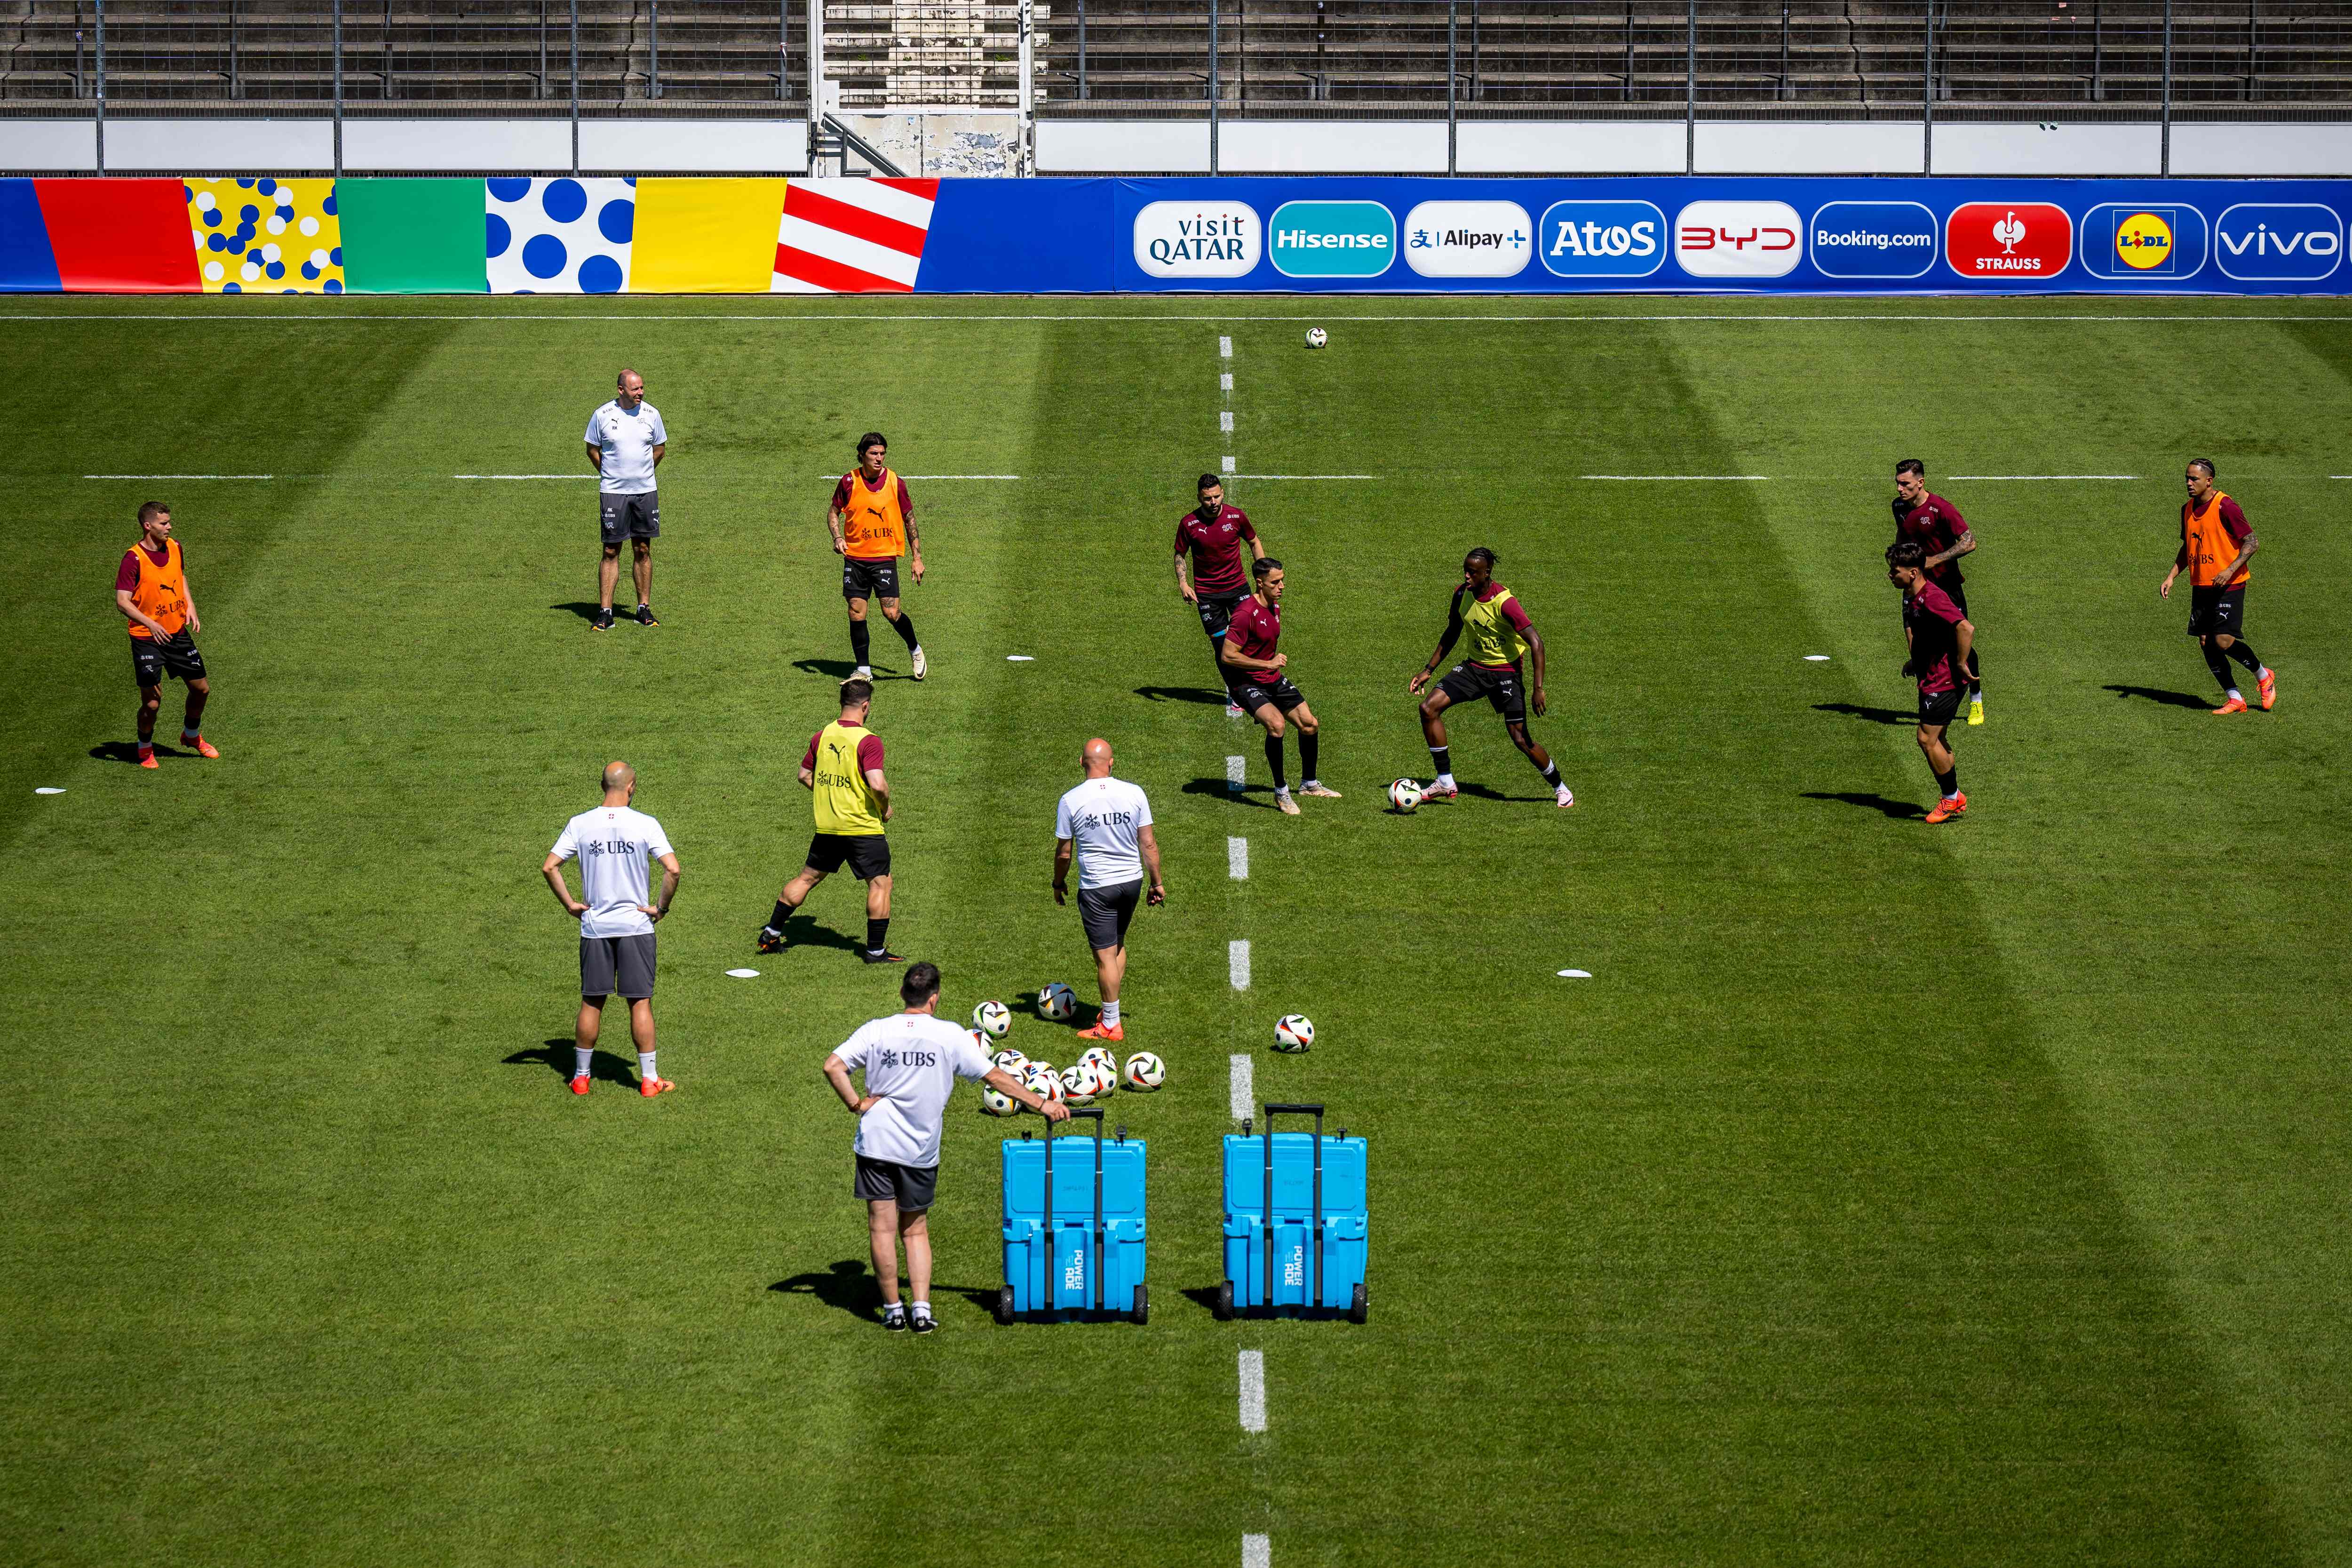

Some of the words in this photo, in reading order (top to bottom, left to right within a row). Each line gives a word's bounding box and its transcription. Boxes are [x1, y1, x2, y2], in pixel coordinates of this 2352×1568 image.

[1178, 214, 1244, 236] visit
[1278, 230, 1387, 248] Hisense
[1682, 228, 1795, 250] BYD
[1818, 230, 1931, 249] Booking.com
[2220, 223, 2338, 255] vivo
[1150, 239, 1244, 265] QATAR
[1976, 258, 2041, 270] STRAUSS
[874, 528, 894, 538] UBS
[169, 597, 185, 613] UBS
[1485, 635, 1506, 649] UBS
[829, 774, 851, 788] UBS
[1103, 812, 1131, 826] UBS
[606, 841, 634, 854] UBS
[902, 1051, 936, 1067] UBS
[1074, 1250, 1083, 1289] POWER
[1285, 1263, 1294, 1286] ADE
[1294, 1246, 1303, 1286] POWER
[1065, 1267, 1074, 1290] ADE
